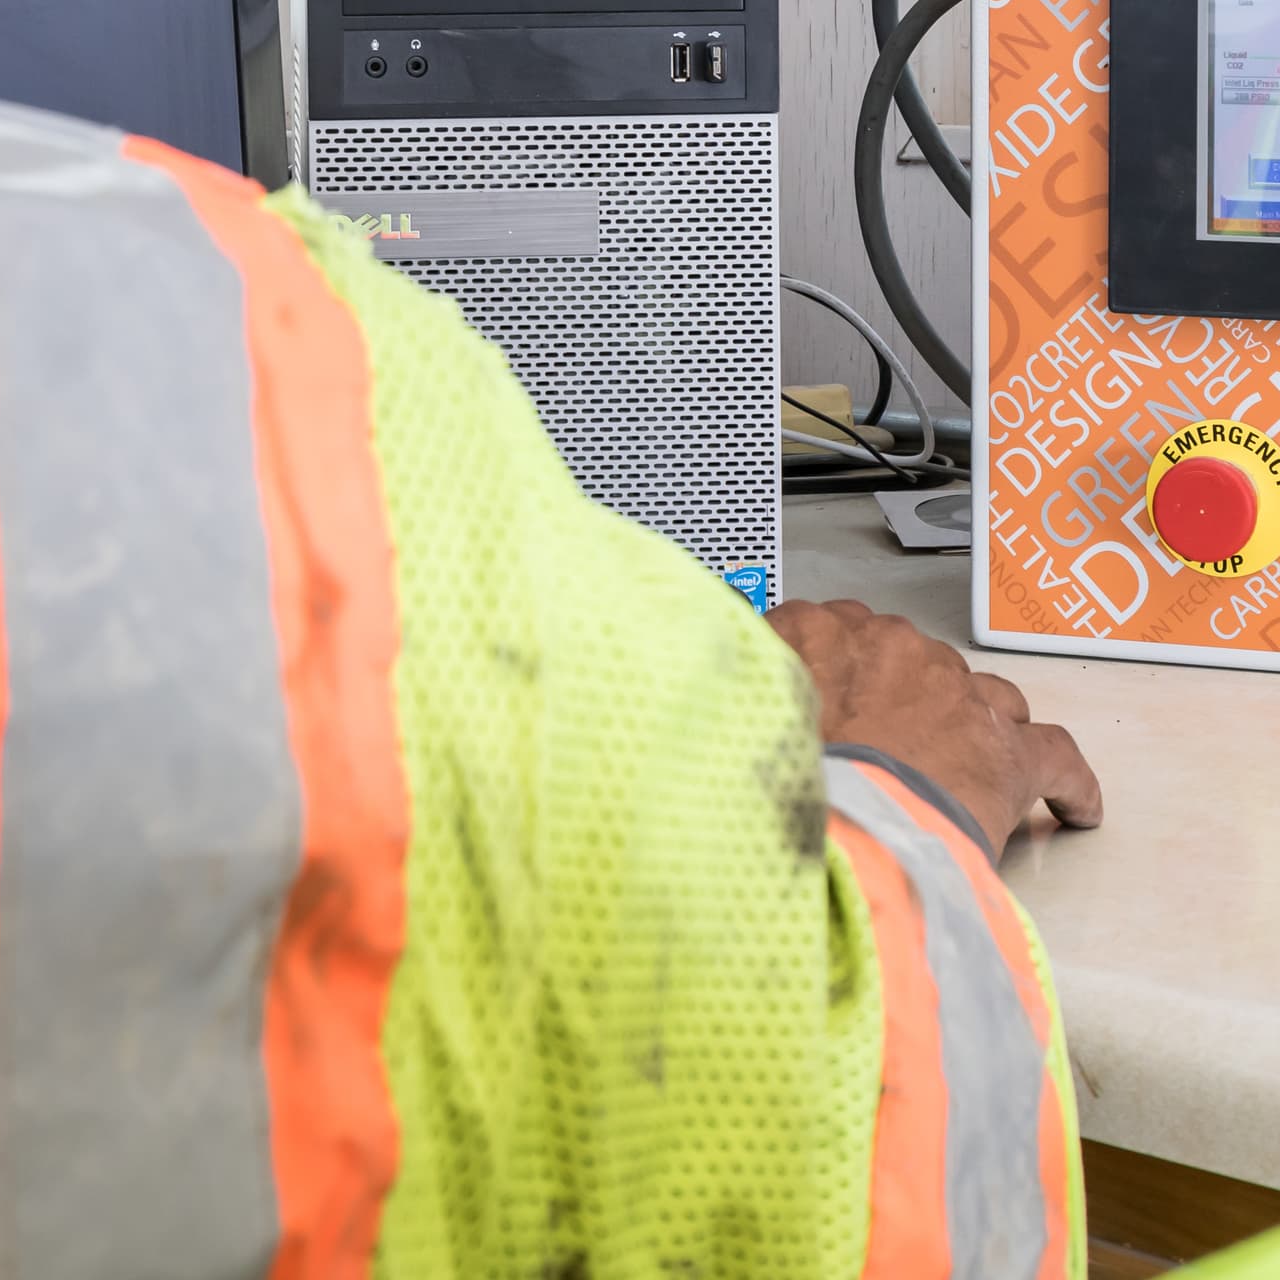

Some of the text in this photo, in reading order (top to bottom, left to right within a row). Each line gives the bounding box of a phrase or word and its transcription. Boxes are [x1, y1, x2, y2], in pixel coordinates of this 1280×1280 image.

[1224, 51, 1248, 61] Liquid
[1227, 62, 1244, 70] CO2
[328, 212, 420, 240] DELL
[995, 331, 1162, 497] DESIGN
[1041, 380, 1206, 547] GREEN
[989, 490, 1112, 639] HEALTH
[734, 575, 757, 587] intel
